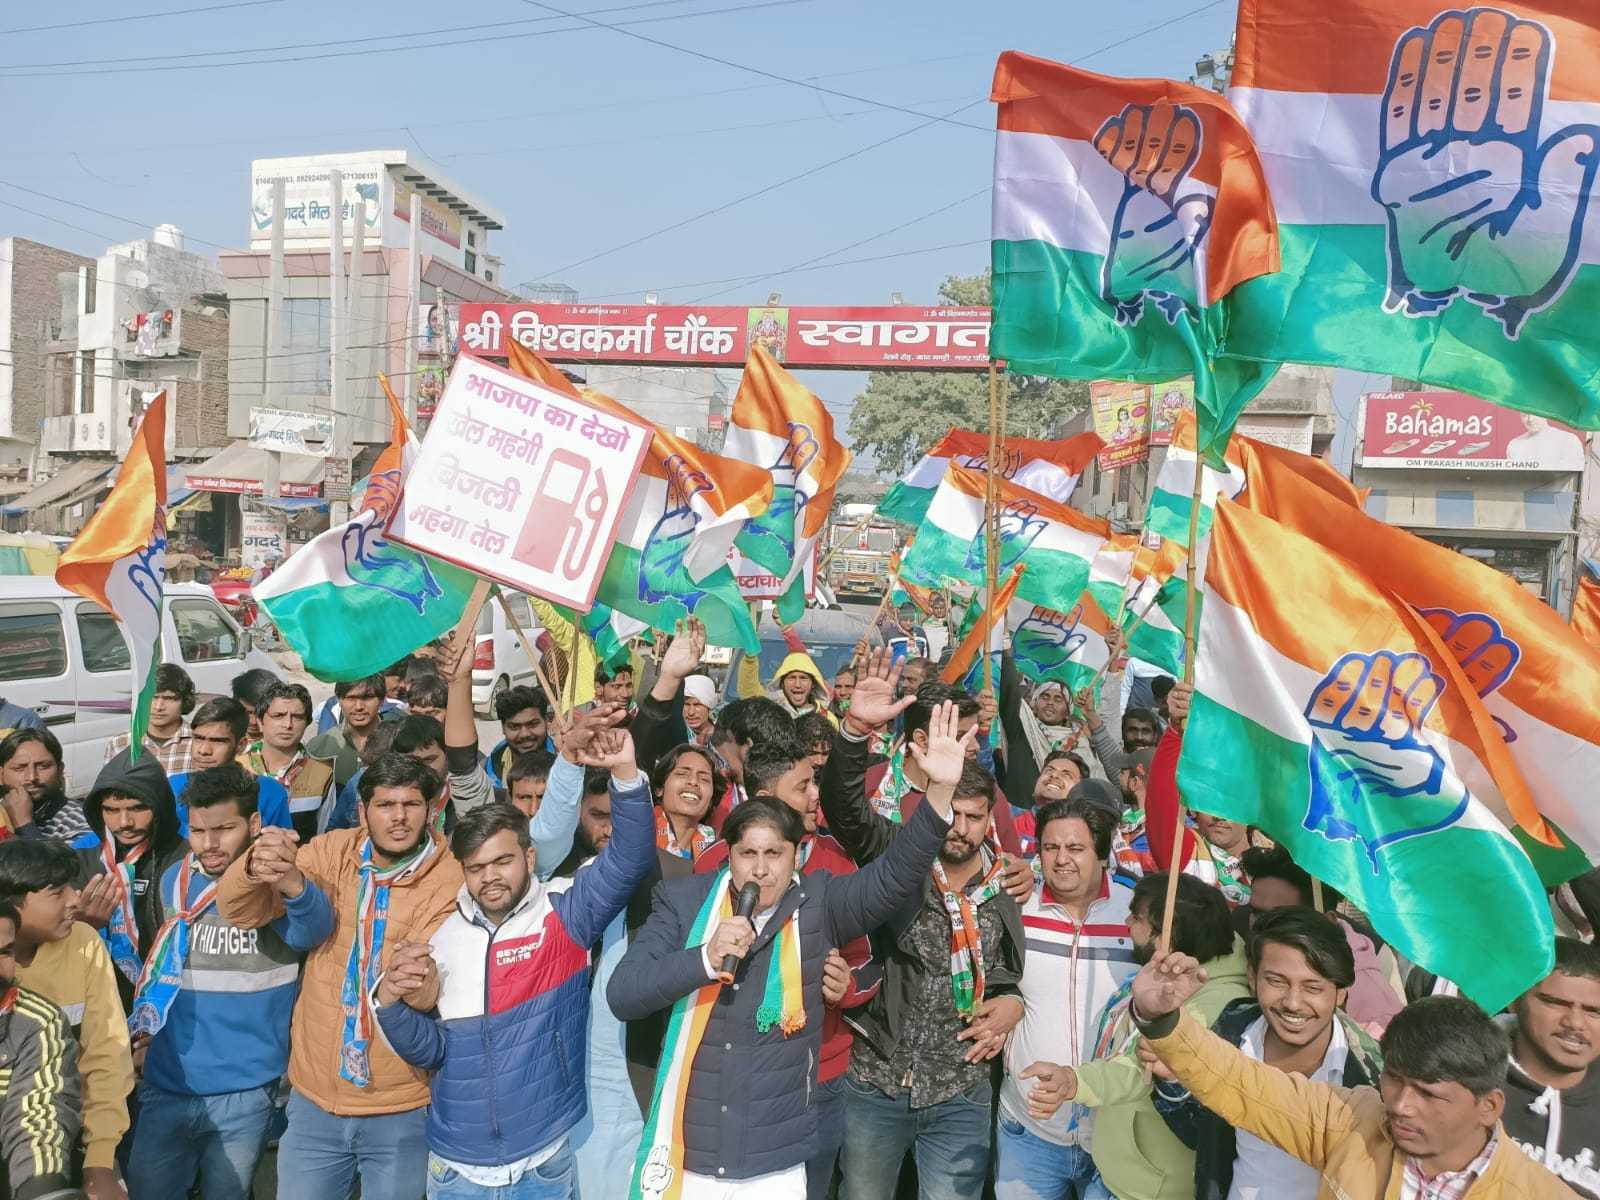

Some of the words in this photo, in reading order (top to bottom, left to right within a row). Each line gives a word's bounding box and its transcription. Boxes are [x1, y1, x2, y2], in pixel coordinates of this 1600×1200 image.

[463, 310, 503, 350] श्री
[510, 311, 657, 354] विश्वकर्मा
[798, 320, 991, 347] स्वागत
[465, 373, 542, 417] भाजपा
[543, 402, 578, 432] का
[580, 413, 631, 453] देखो
[1385, 409, 1494, 437] Bahamas
[1406, 459, 1422, 467] OM
[1423, 459, 1463, 468] PRAKASH
[1464, 460, 1502, 468] MUKESH
[1504, 460, 1540, 469] CHAND
[469, 519, 510, 555] तेल
